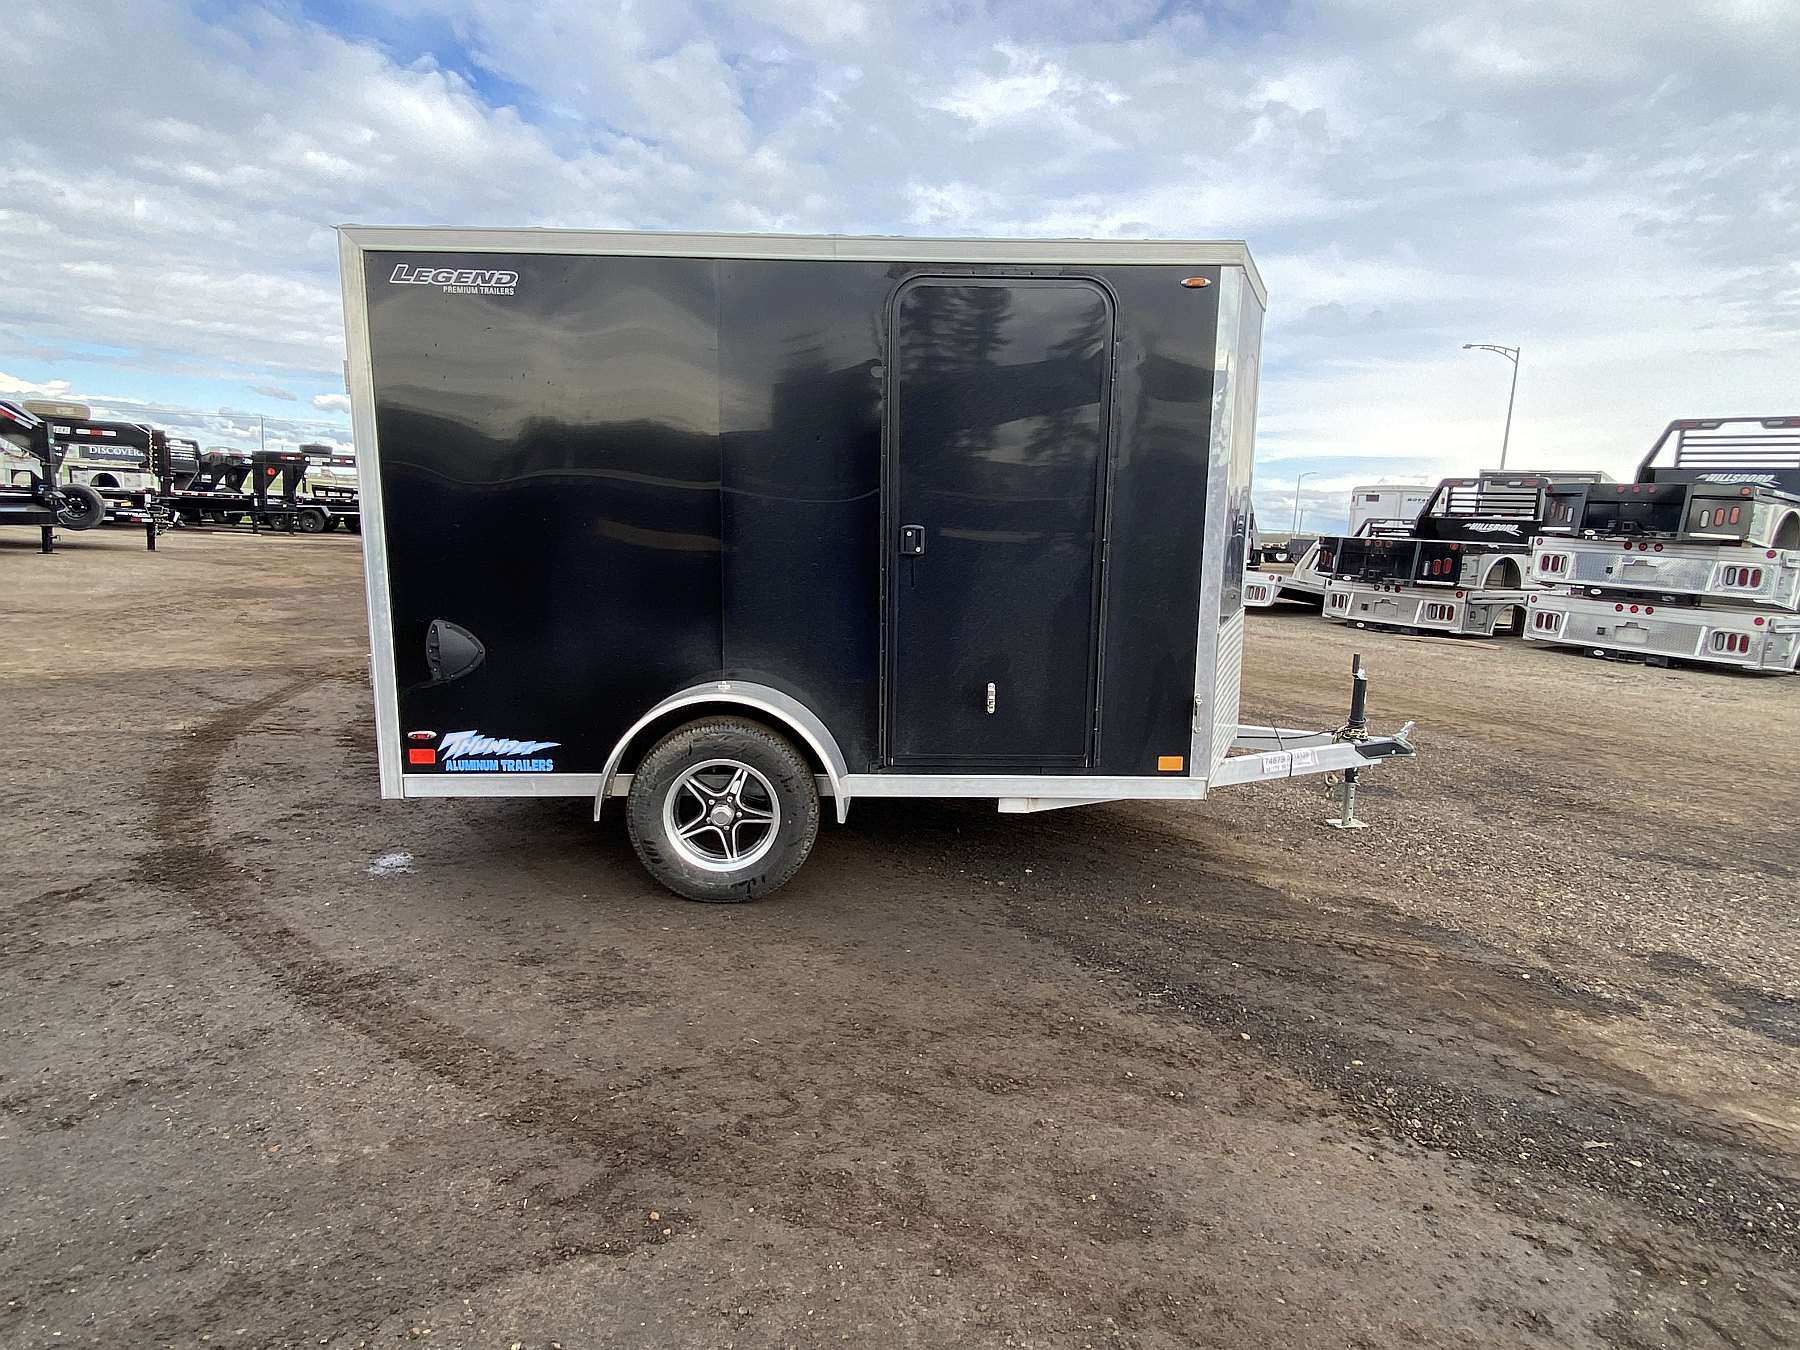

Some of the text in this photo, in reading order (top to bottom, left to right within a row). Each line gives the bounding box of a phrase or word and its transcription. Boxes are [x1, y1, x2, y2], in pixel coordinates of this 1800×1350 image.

[389, 264, 519, 287] LEGEND
[443, 285, 515, 296] PREMIUM TRAILERS
[1698, 473, 1777, 486] HILLSBORO
[1464, 522, 1521, 534] HILLSBORO
[446, 759, 554, 772] ALUMINUM TRAILERS
